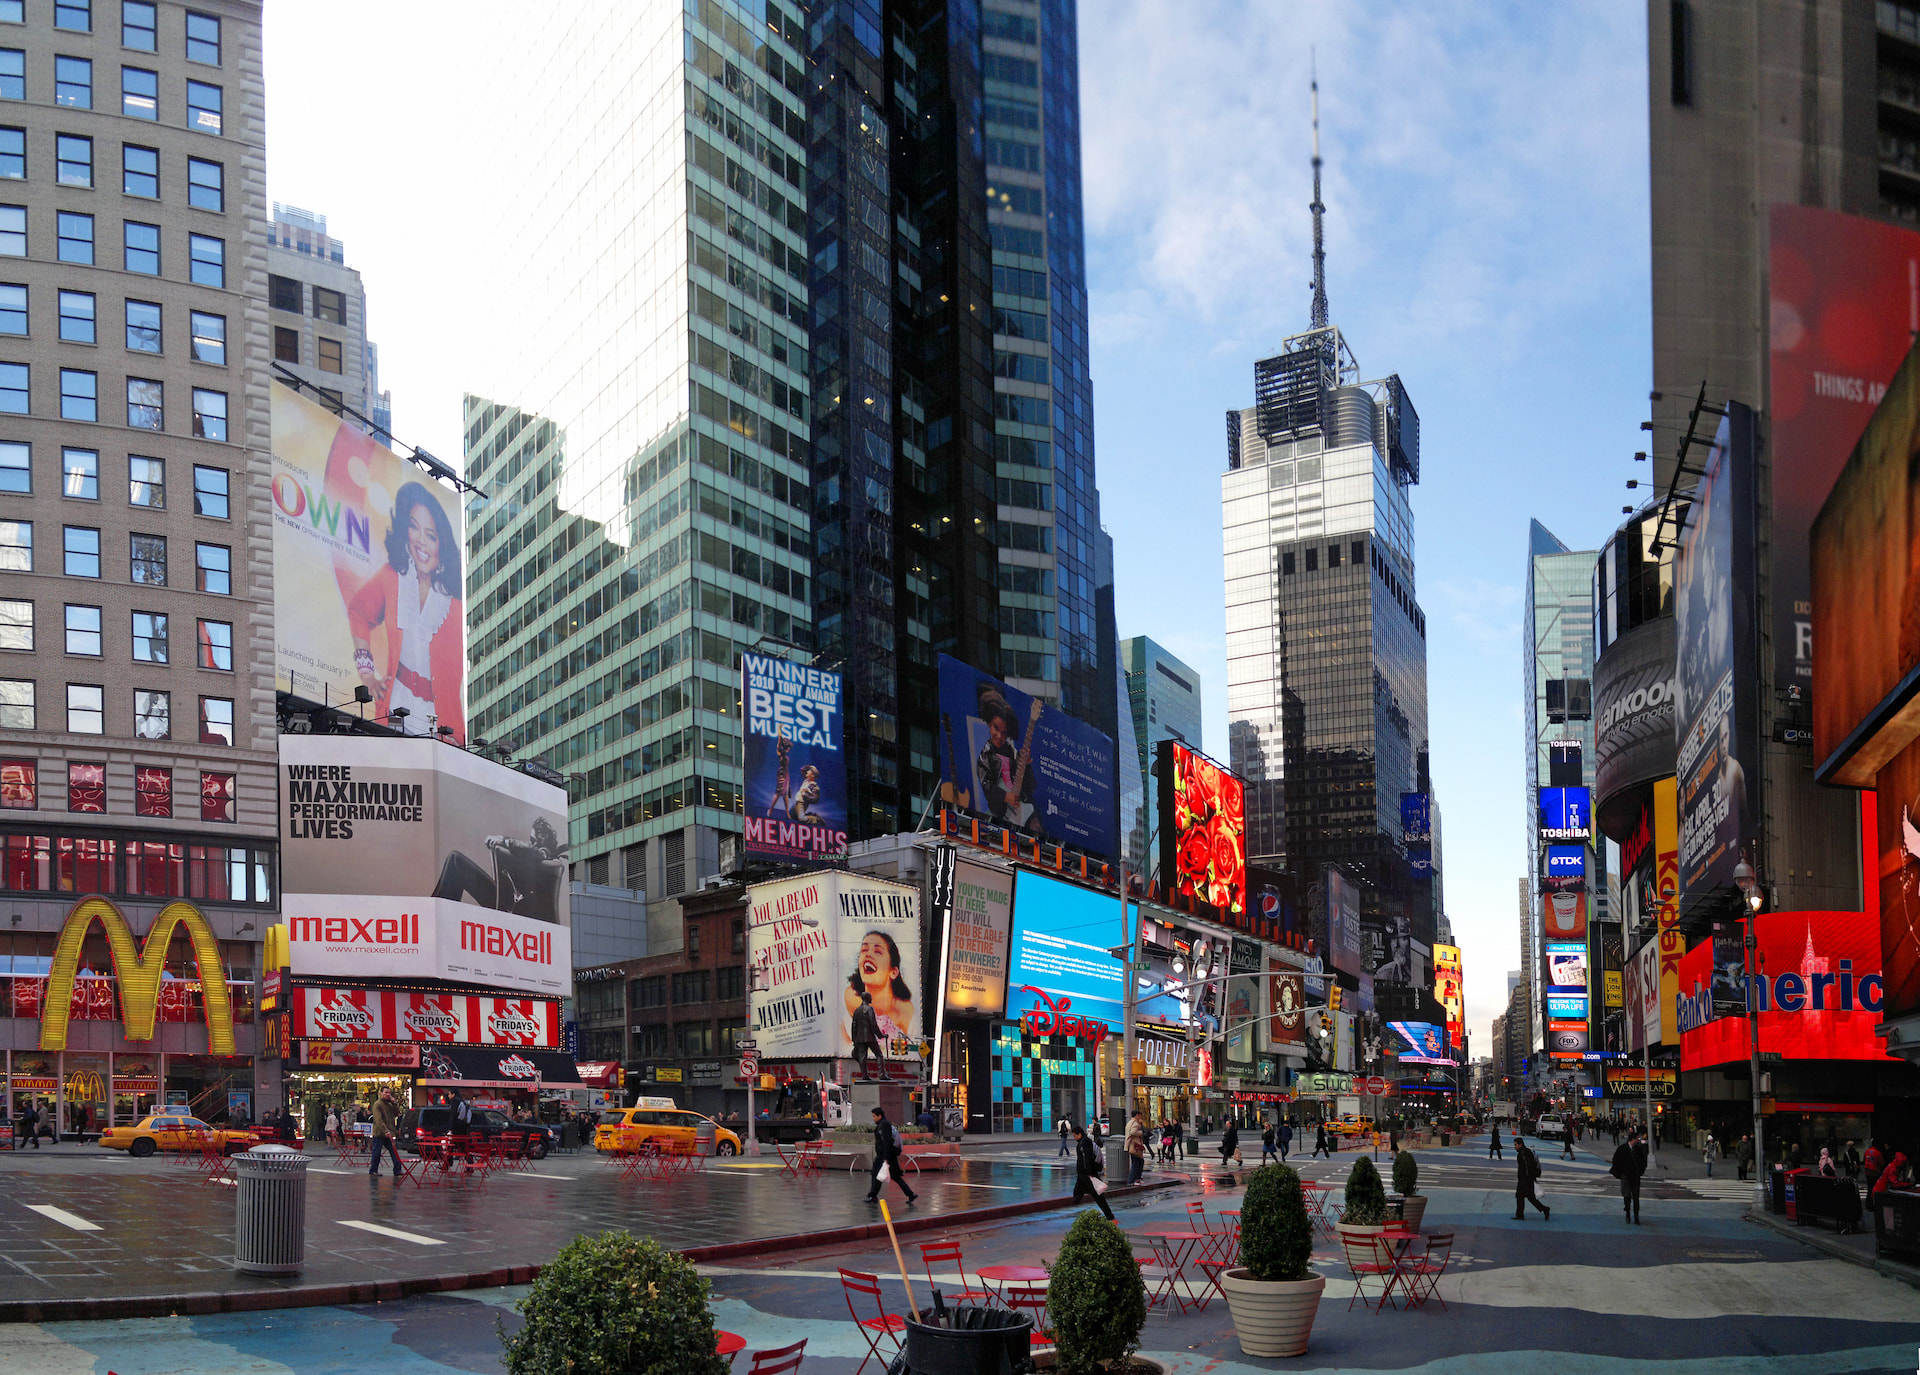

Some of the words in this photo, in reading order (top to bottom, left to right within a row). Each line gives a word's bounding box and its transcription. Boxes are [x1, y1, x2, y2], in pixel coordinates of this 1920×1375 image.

[1815, 372, 1864, 402] THINGS
[272, 453, 308, 480] Introducing
[272, 472, 370, 554] OWN
[274, 513, 286, 524] THE
[287, 519, 301, 530] NEW
[278, 644, 315, 668] Launching
[316, 658, 342, 678] January
[744, 653, 840, 693] WINNER!
[750, 674, 774, 691] 2010
[777, 679, 802, 697] TONY
[805, 686, 836, 705] AWARD
[750, 687, 836, 732] BEST
[1631, 703, 1676, 725] emotio
[750, 717, 838, 750] MUSICAL
[288, 765, 351, 781] WHERE
[290, 781, 423, 806] MAXIMUM
[290, 803, 423, 822] PERFORMANCE
[290, 819, 353, 839] LIVES
[745, 816, 847, 855] MEMPHIS
[1541, 828, 1590, 838] TOSHIBA
[1558, 857, 1582, 865] TDK
[957, 880, 985, 900] YOU'VE
[986, 888, 1009, 905] MADE
[754, 901, 773, 925] YOU
[776, 884, 819, 918] ALREADY
[839, 893, 886, 917] MAMMA
[887, 896, 914, 918] MIA!
[956, 895, 964, 908] IT
[965, 896, 988, 914] HERE.
[1658, 850, 1683, 978] Kodak
[290, 913, 419, 944] maxell
[774, 912, 803, 940] KNOW
[955, 908, 972, 923] BUT
[973, 911, 992, 928] WILL
[1343, 914, 1361, 936] TASTE
[461, 920, 552, 965] maxell
[793, 929, 828, 957] GONNA
[955, 922, 971, 938] YOU
[972, 925, 983, 940] BE
[984, 928, 1004, 944] ABLE
[325, 946, 419, 954] www.maxell.com
[953, 936, 966, 950] TO
[966, 938, 994, 955] RETIRE
[1236, 942, 1253, 956] NYC's
[772, 960, 799, 986] LOVE
[800, 954, 815, 978] IT!
[952, 949, 1001, 969] ANYWHERE?
[952, 963, 962, 972] ASK
[963, 965, 975, 975] TEAM
[1231, 953, 1260, 970] AMOUS
[960, 984, 986, 993] Ameritrade
[1606, 984, 1621, 992] LION
[1606, 993, 1621, 1001] KING
[757, 999, 798, 1028] MAMMA
[800, 990, 825, 1019] MIA!
[1676, 981, 1703, 1033] Bank
[1137, 1038, 1190, 1067] FOREVE
[1606, 1060, 1676, 1068] MARQUIS
[1235, 1092, 1257, 1102] PLANET
[1258, 1093, 1290, 1103] HOLLYWOOD
[1609, 1081, 1675, 1096] WONDELAND
